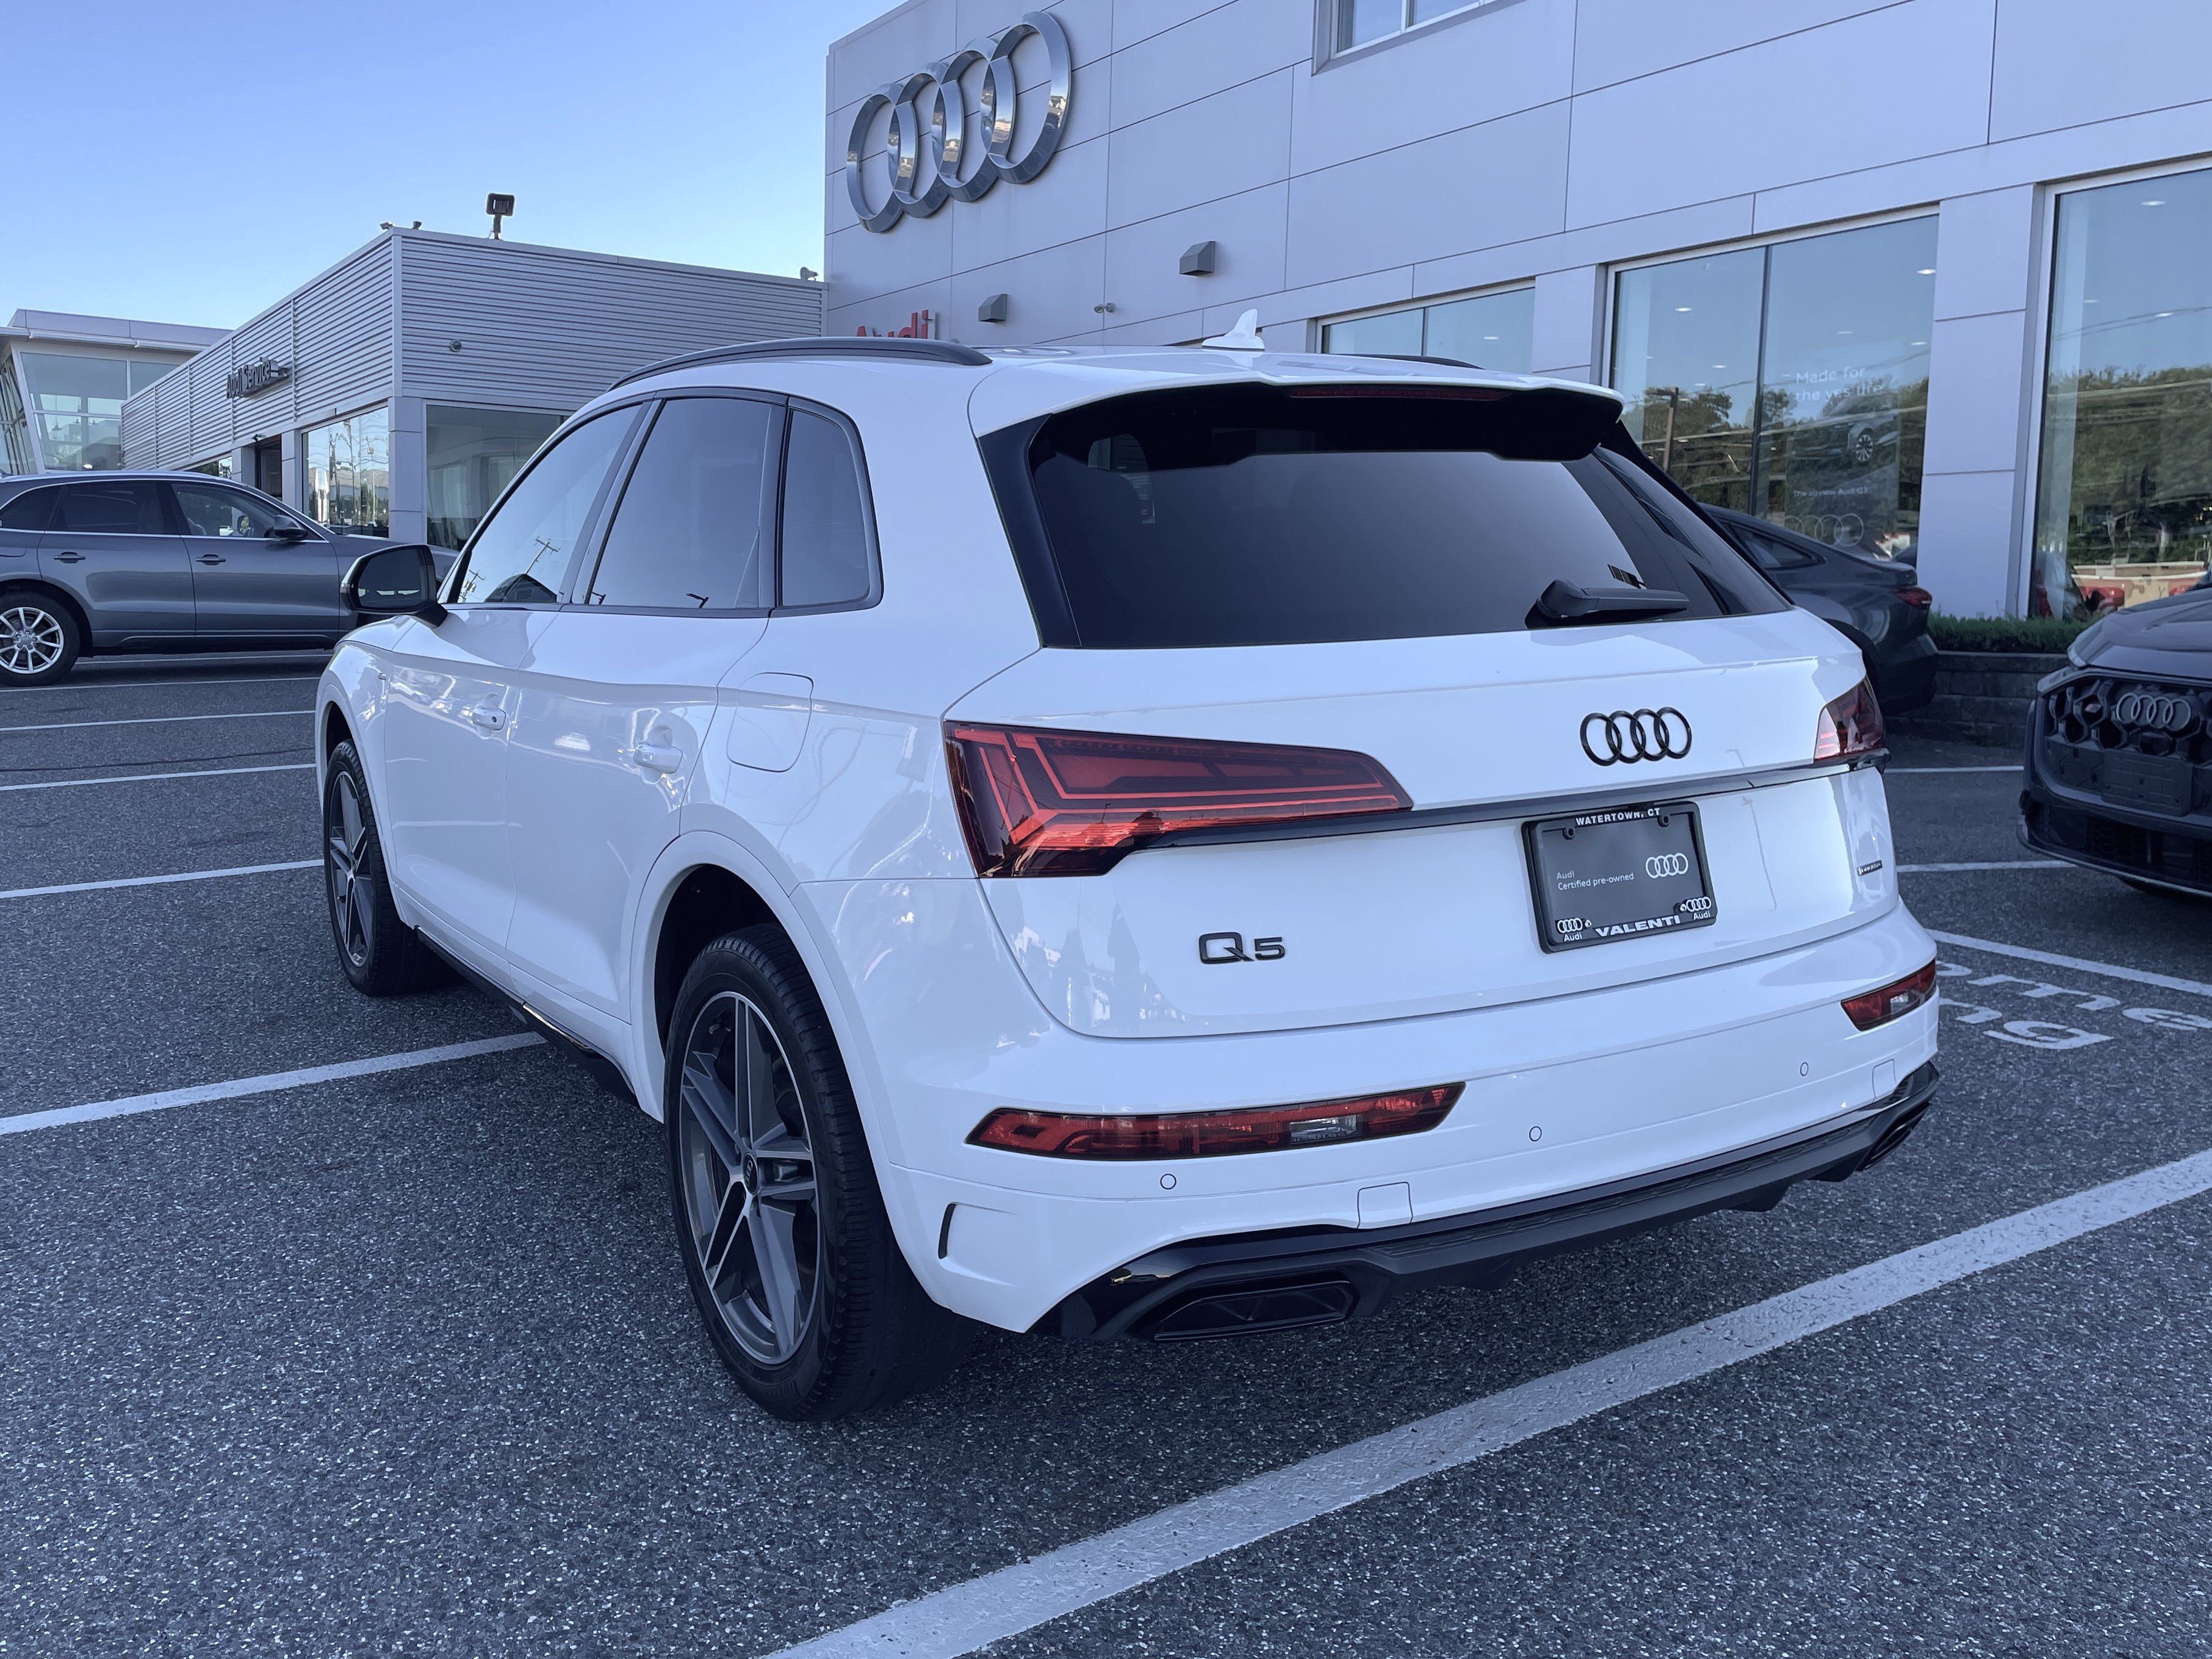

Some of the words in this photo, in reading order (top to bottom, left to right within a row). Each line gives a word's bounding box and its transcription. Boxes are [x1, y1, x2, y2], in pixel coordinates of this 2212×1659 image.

[226, 367, 244, 398] Audi
[244, 357, 272, 389] Service
[1796, 369, 1837, 384] Made
[1843, 366, 1865, 379] for
[1576, 810, 1644, 826] WATERTOWN,
[1647, 807, 1660, 817] CT
[1556, 869, 1575, 880] Audi
[1558, 877, 1591, 891] Certified
[1593, 873, 1634, 887] pre-owned
[1693, 910, 1710, 920] Audi
[1595, 915, 1681, 937] VALENTI
[1563, 932, 1582, 942] Audi
[1198, 932, 1285, 964] Q5
